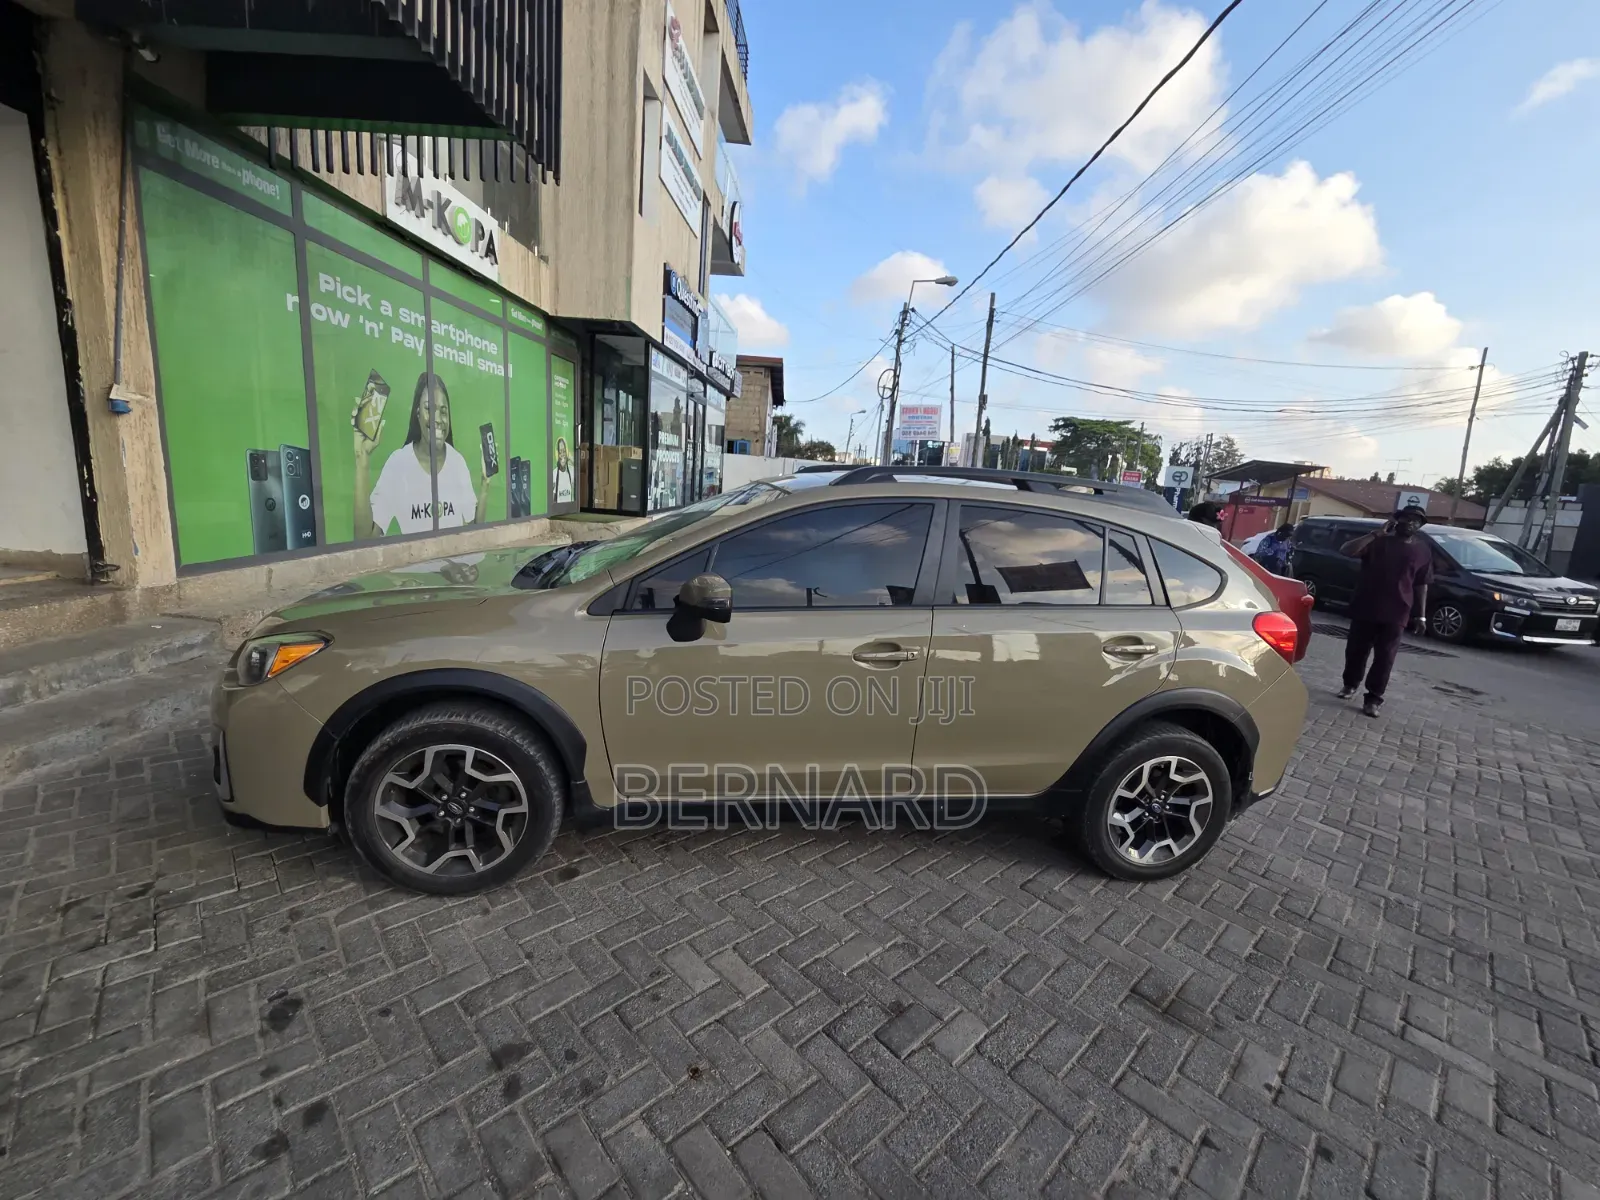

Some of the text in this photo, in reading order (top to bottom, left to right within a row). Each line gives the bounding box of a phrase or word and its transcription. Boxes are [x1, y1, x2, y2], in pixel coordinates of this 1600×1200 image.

[184, 138, 220, 169] More
[242, 167, 280, 200] phone!
[395, 173, 499, 266] M-KOPA
[319, 272, 498, 355] Pick a smartphone
[391, 326, 425, 356] Pay
[433, 343, 474, 367] small
[477, 358, 513, 378] smal
[658, 430, 679, 447] PREMIUM
